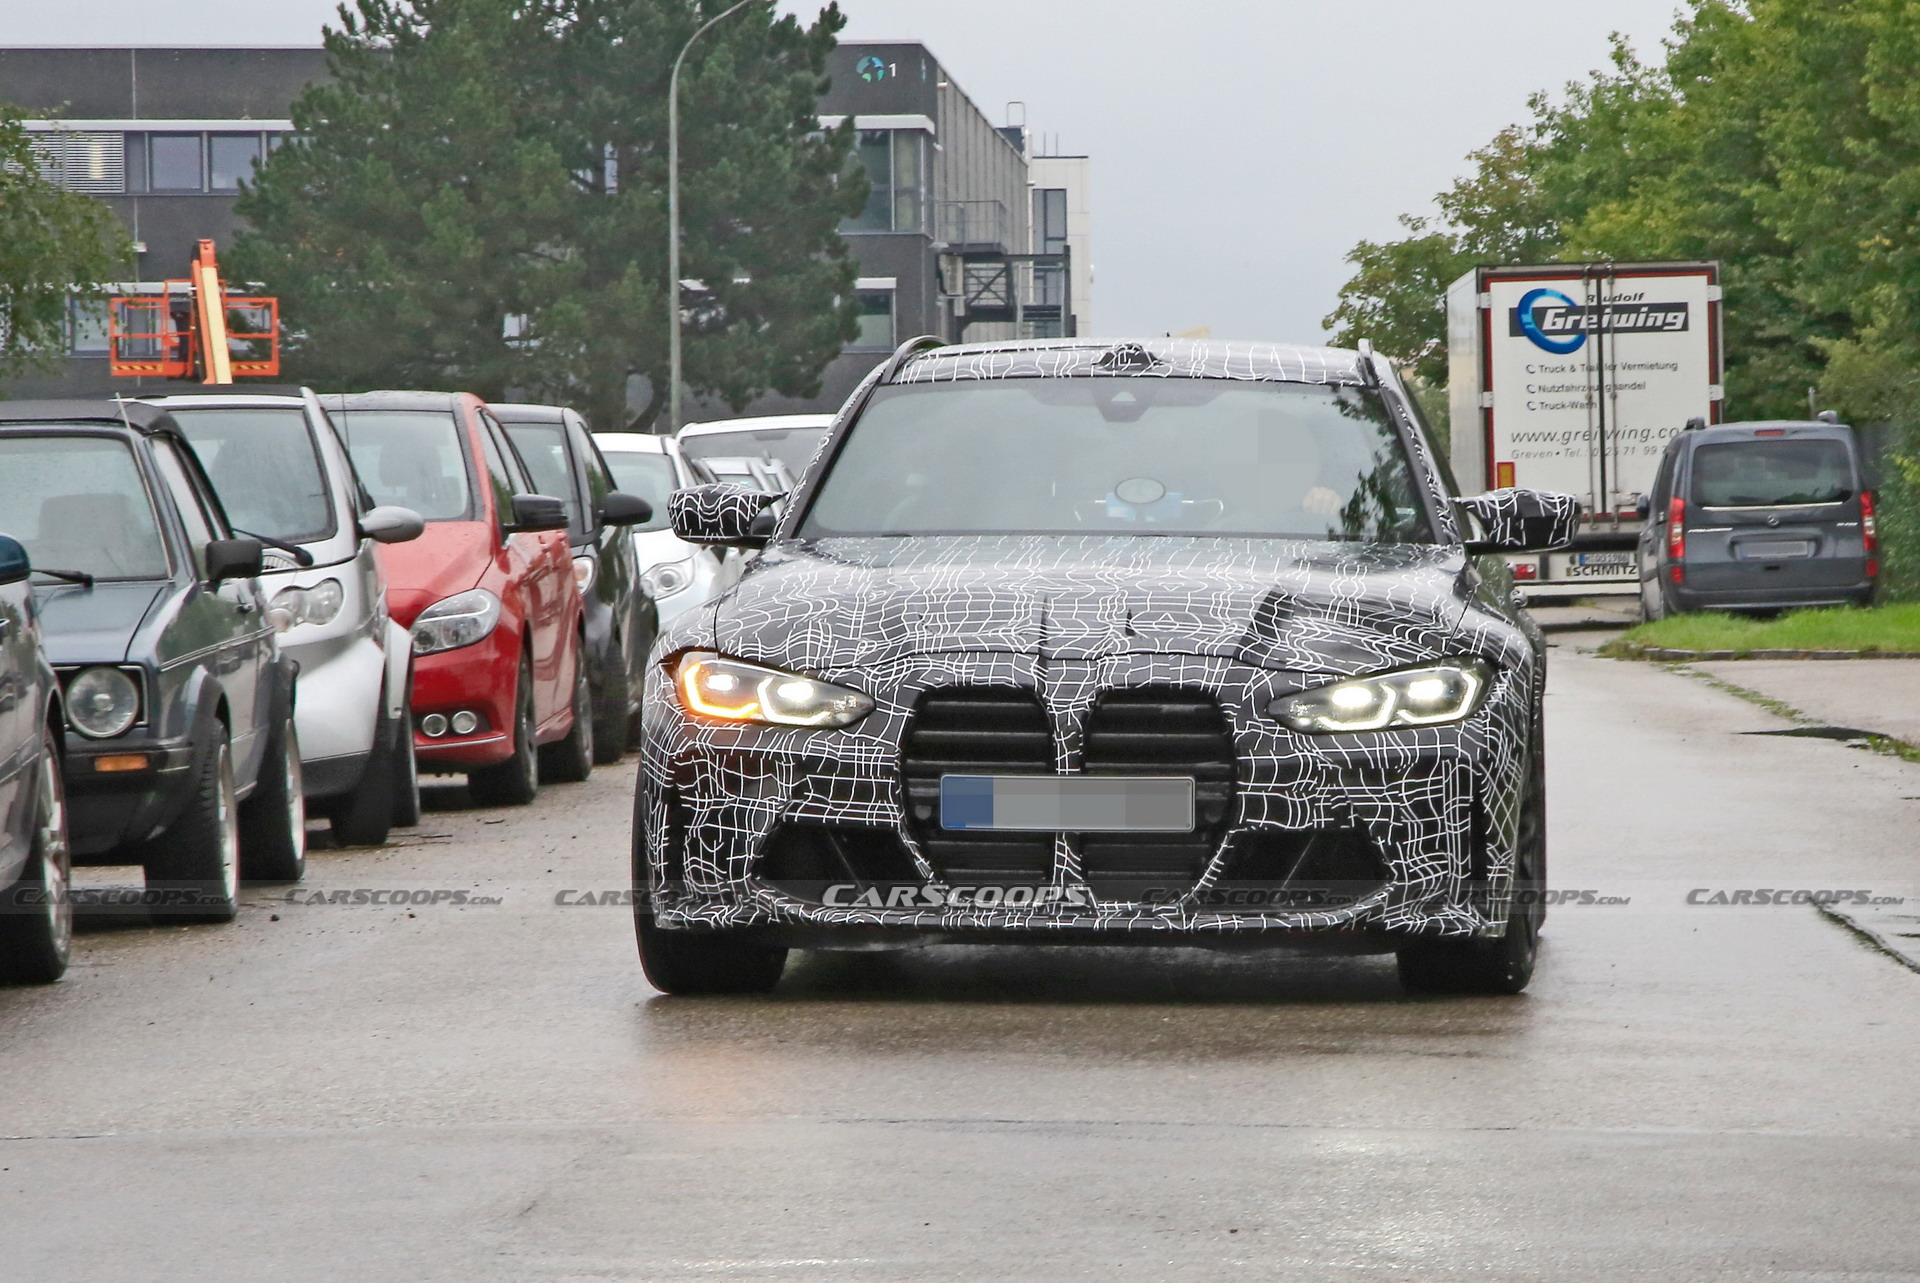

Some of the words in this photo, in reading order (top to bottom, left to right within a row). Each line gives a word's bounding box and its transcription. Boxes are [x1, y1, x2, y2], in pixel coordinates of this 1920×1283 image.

[888, 62, 897, 77] 1
[1541, 306, 1687, 331] Greiwing
[1538, 364, 1567, 373] Truck
[1569, 364, 1577, 373] &
[1621, 361, 1679, 372] Vermietung
[1511, 425, 1680, 446] www.greiwing.co
[1511, 449, 1554, 459] Greven
[1572, 565, 1638, 577] SCHMITZ
